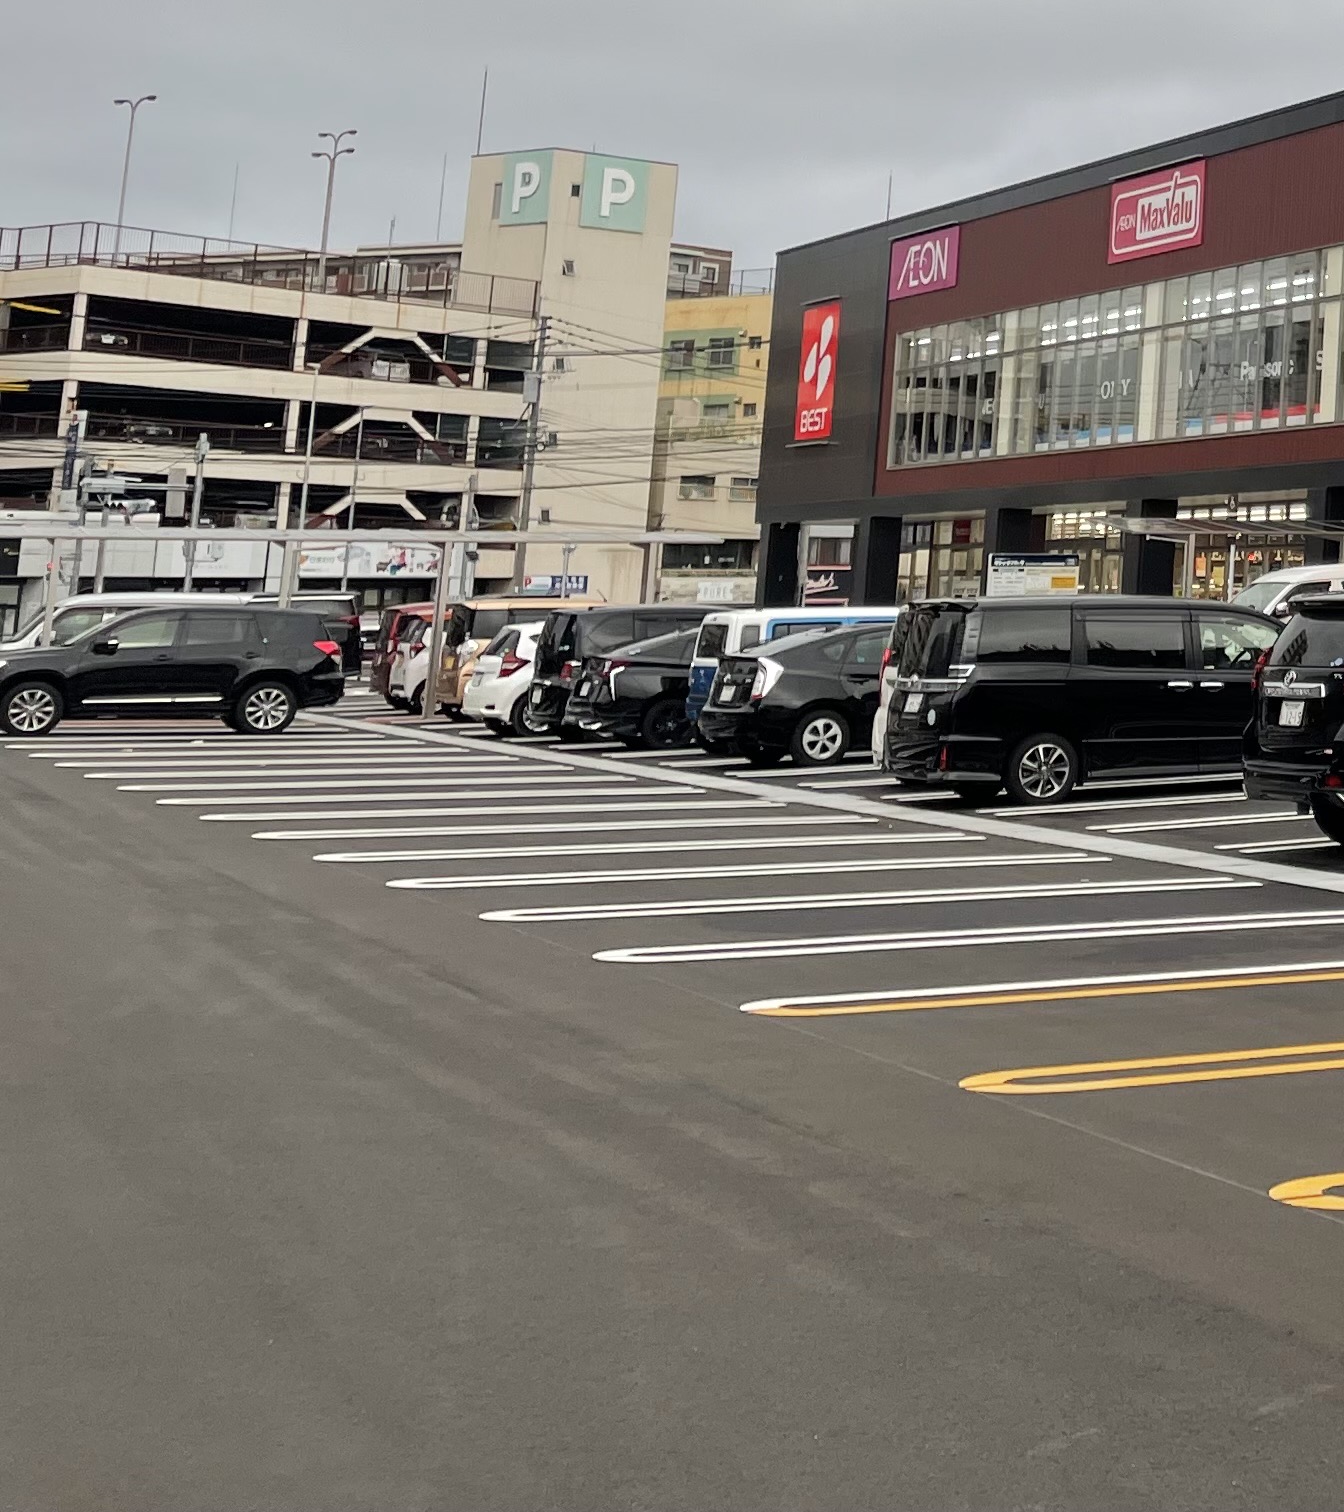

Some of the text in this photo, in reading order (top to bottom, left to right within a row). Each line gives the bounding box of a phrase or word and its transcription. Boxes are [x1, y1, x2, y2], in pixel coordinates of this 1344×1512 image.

[512, 162, 540, 213] P
[600, 168, 635, 217] P
[1140, 175, 1193, 234] MaxValu
[800, 408, 828, 433] BEST
